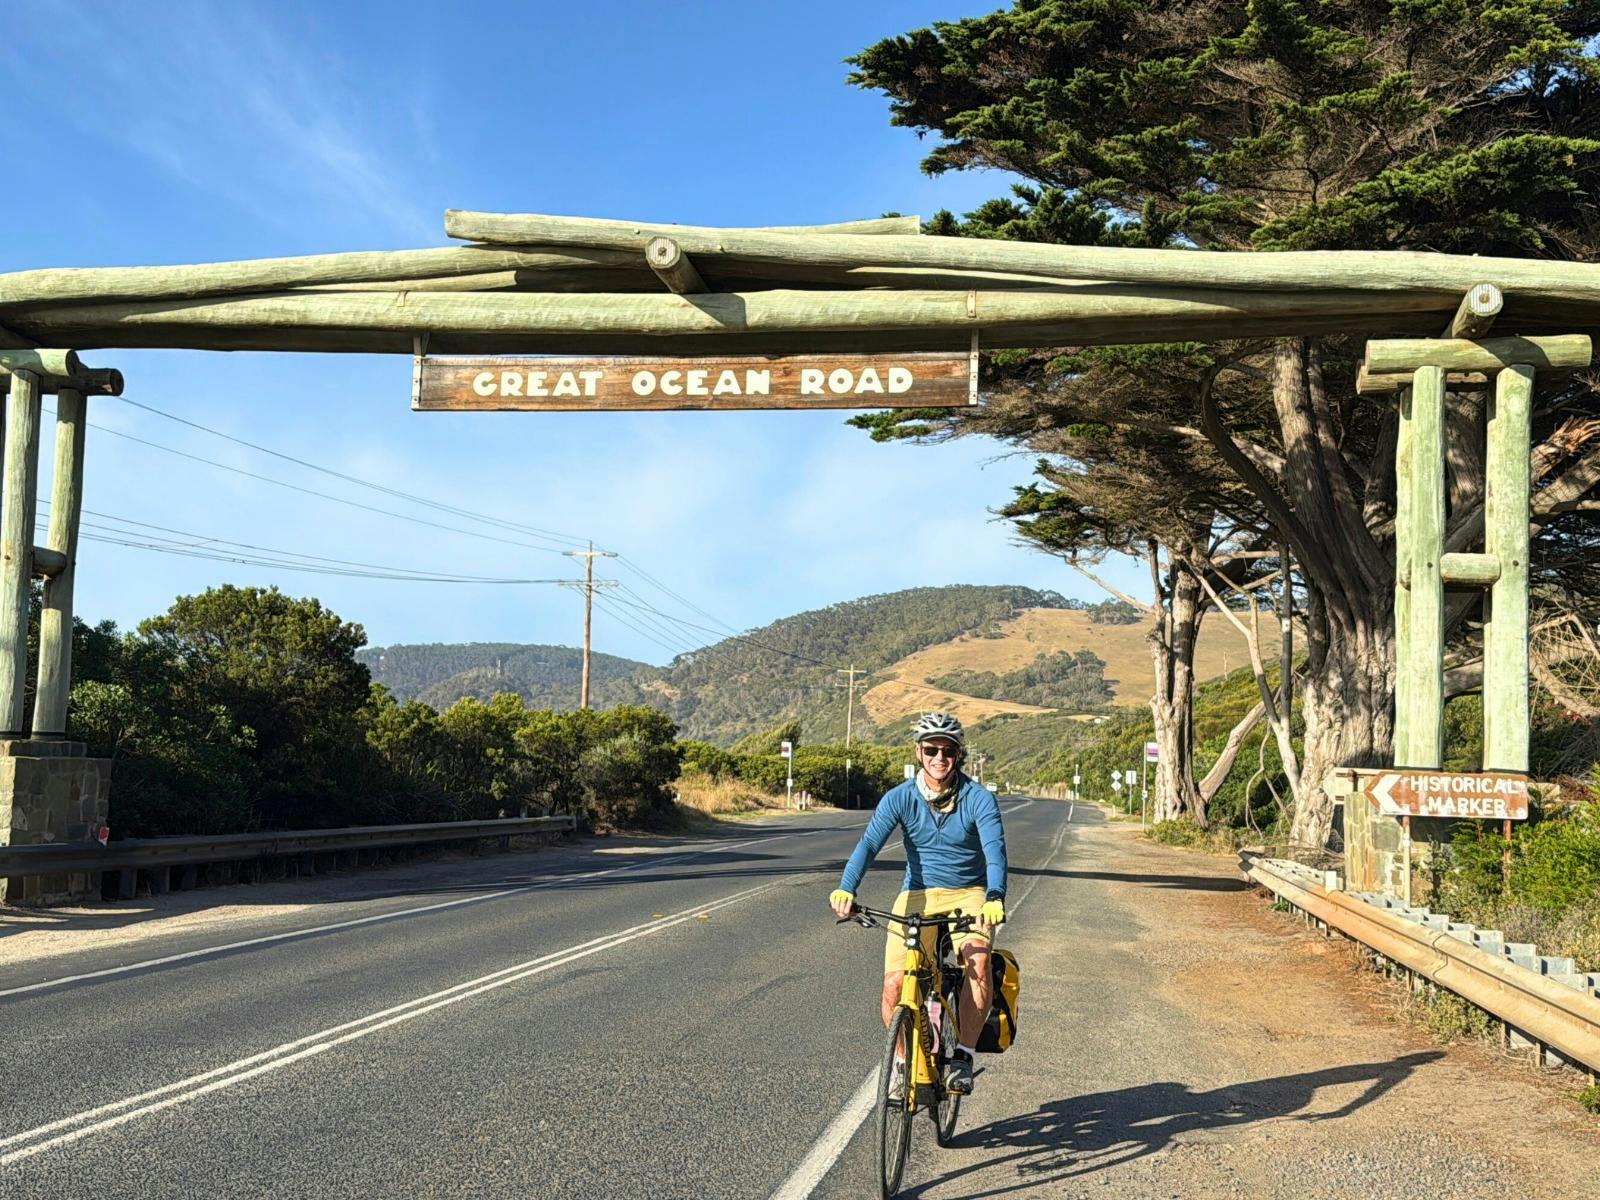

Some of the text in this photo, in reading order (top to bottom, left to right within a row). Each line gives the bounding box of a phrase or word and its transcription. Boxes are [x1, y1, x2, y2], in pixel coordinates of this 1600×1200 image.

[472, 367, 914, 397] GREAT OCEAN ROAD
[1410, 775, 1519, 795] HISTORICAL
[1428, 798, 1507, 817] MARKER
